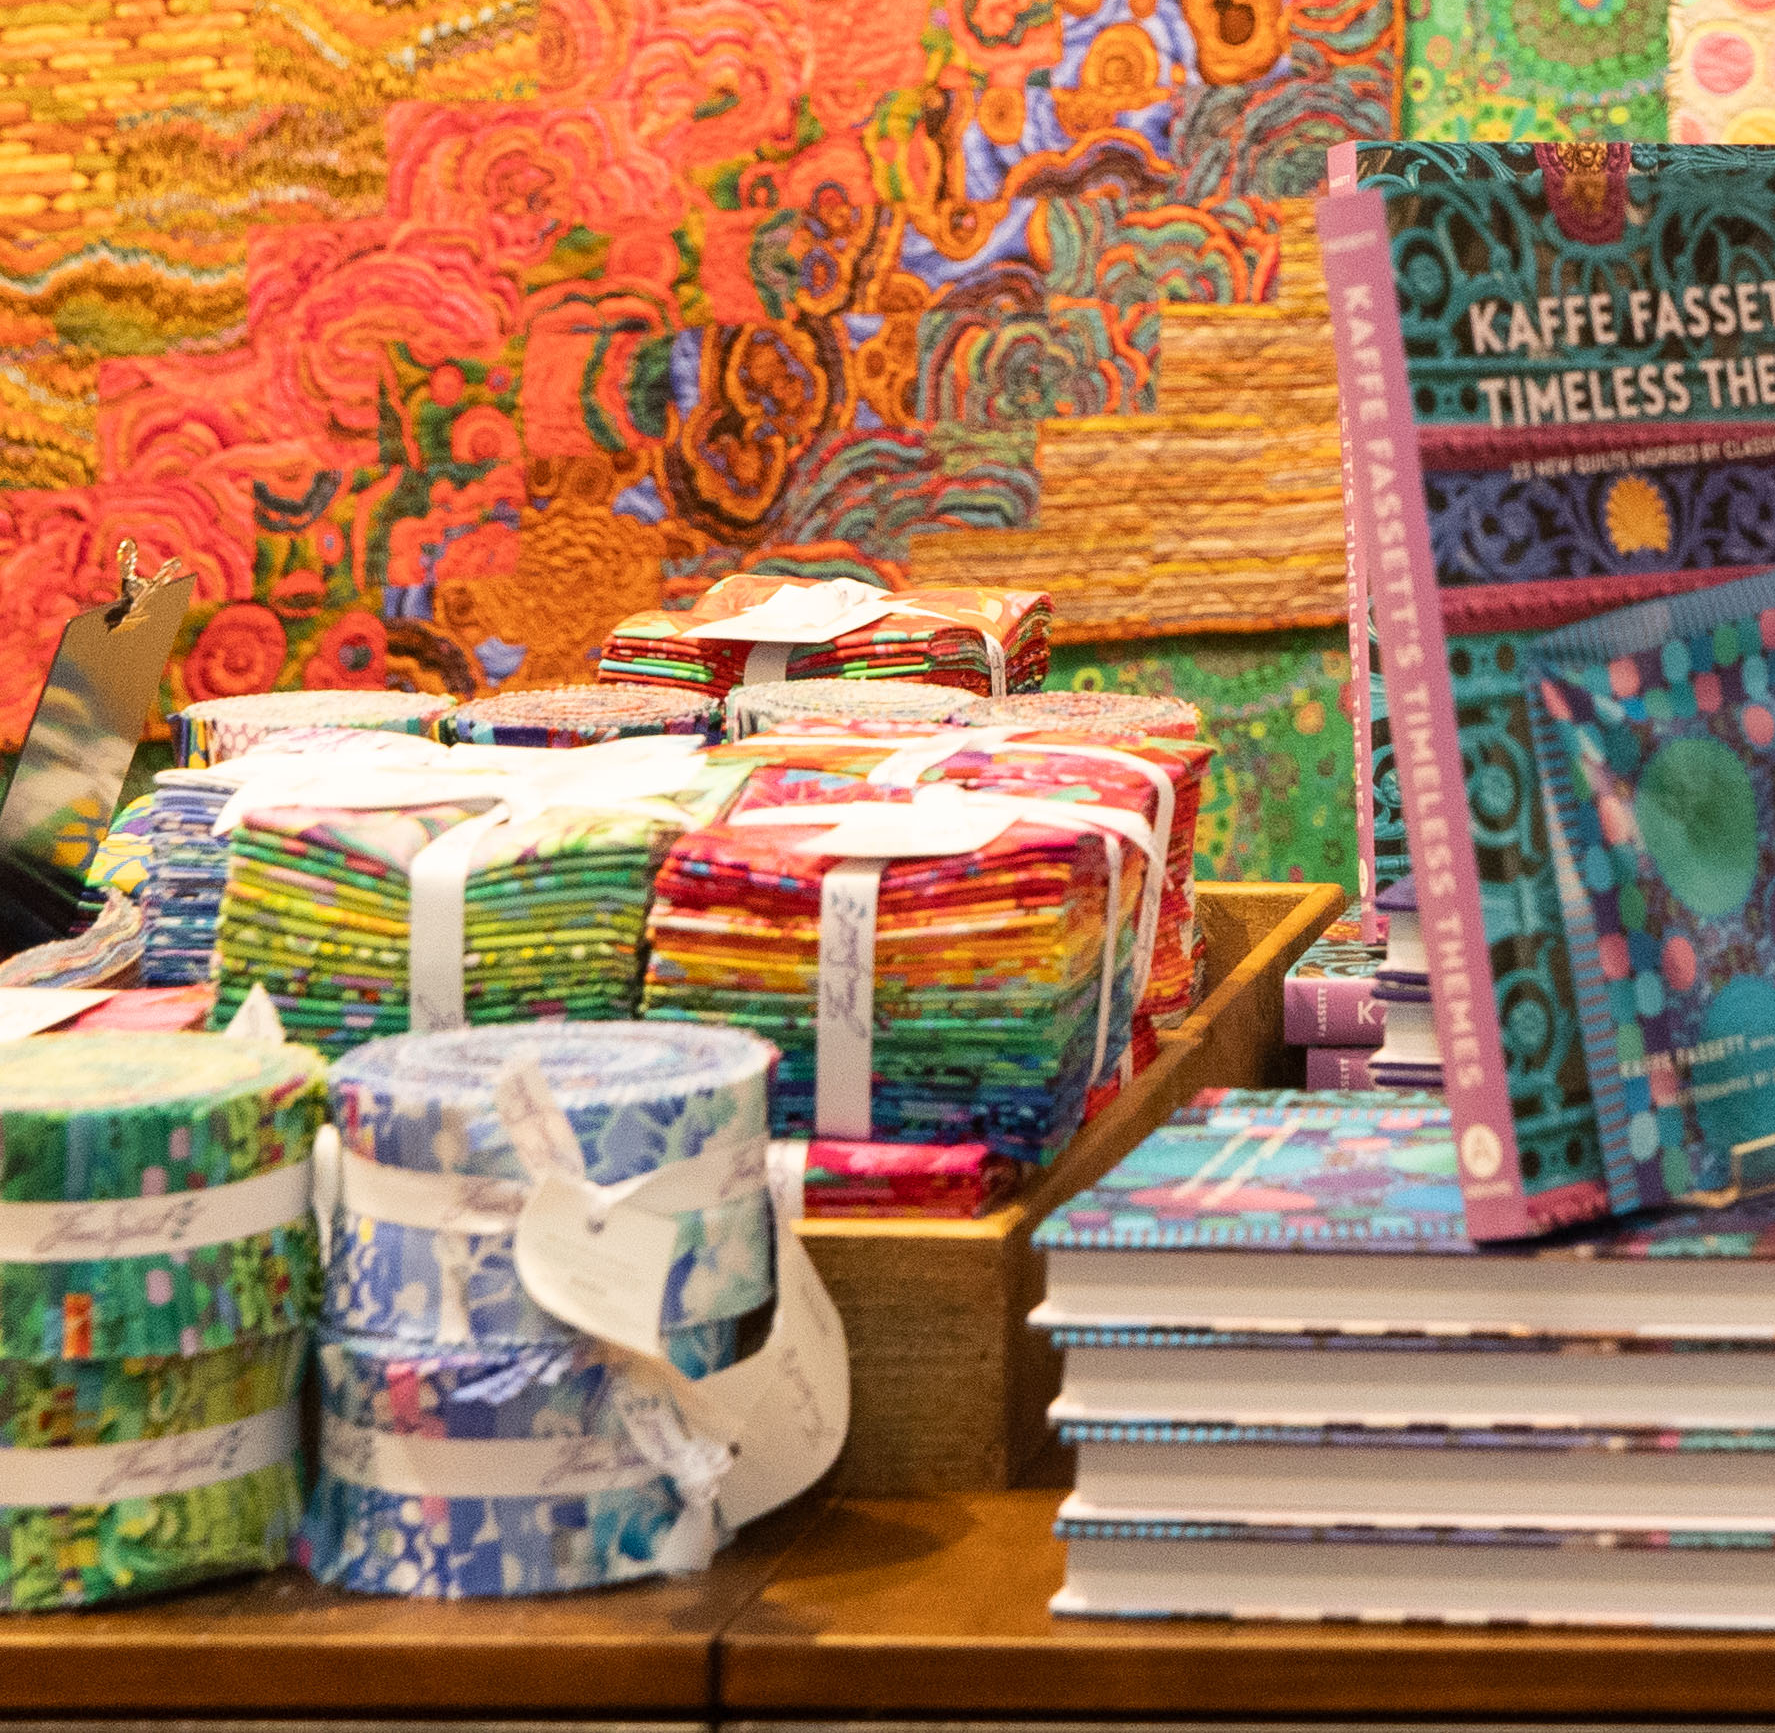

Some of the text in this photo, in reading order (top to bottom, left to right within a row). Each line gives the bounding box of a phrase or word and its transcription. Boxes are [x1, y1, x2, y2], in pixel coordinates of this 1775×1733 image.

[1342, 283, 1388, 423] KAFFE
[1468, 292, 1617, 354] KAFFE
[1477, 362, 1692, 429] TIMELESS
[1364, 437, 1425, 669] FASSETT'S
[1402, 680, 1457, 898] TIMELESS
[1434, 909, 1485, 1091] THEMES
